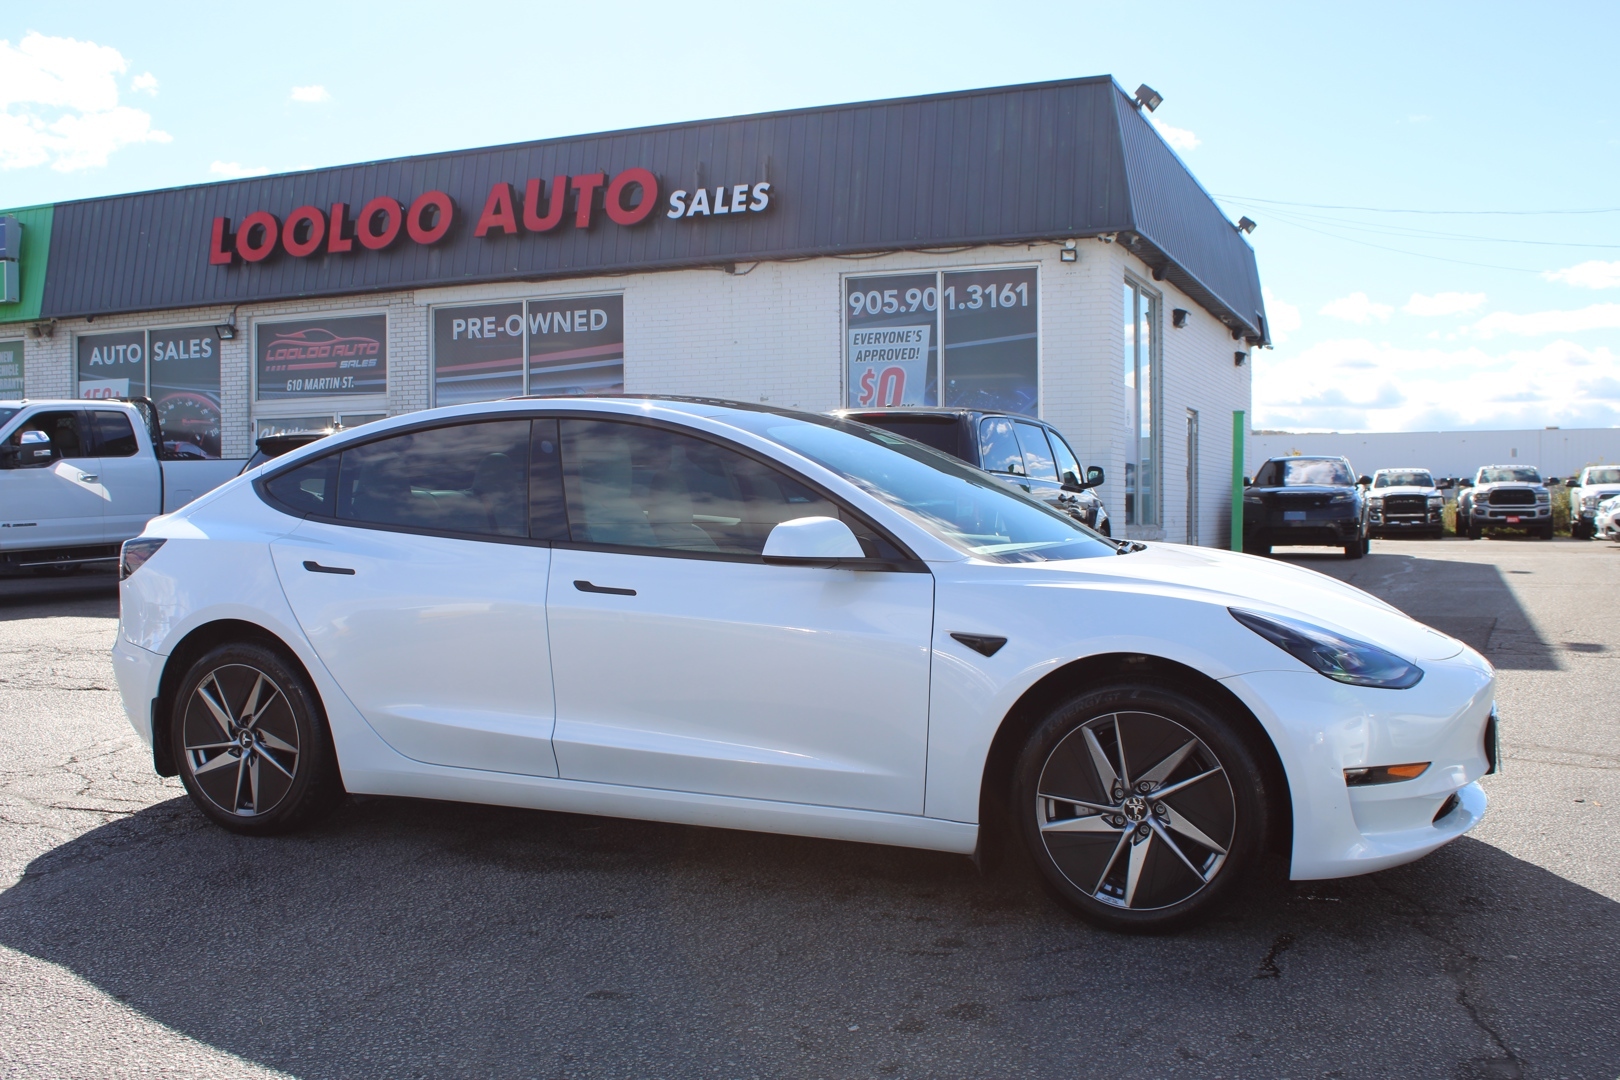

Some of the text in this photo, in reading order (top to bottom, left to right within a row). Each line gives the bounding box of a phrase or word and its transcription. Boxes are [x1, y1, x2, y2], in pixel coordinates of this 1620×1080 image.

[210, 167, 770, 265] LOOLOO AUTO SALES
[849, 282, 1028, 315] 905.901.3161
[452, 309, 608, 340] PRE-OWNED
[853, 330, 922, 346] EVERYONE'S
[89, 338, 212, 366] AUTO SALES
[265, 342, 380, 361] LOOLOO AUTO
[855, 347, 920, 362] APPROVED!
[339, 358, 378, 369] SALES
[286, 376, 355, 391] 610 MARTIN ST.
[859, 366, 906, 407] $0
